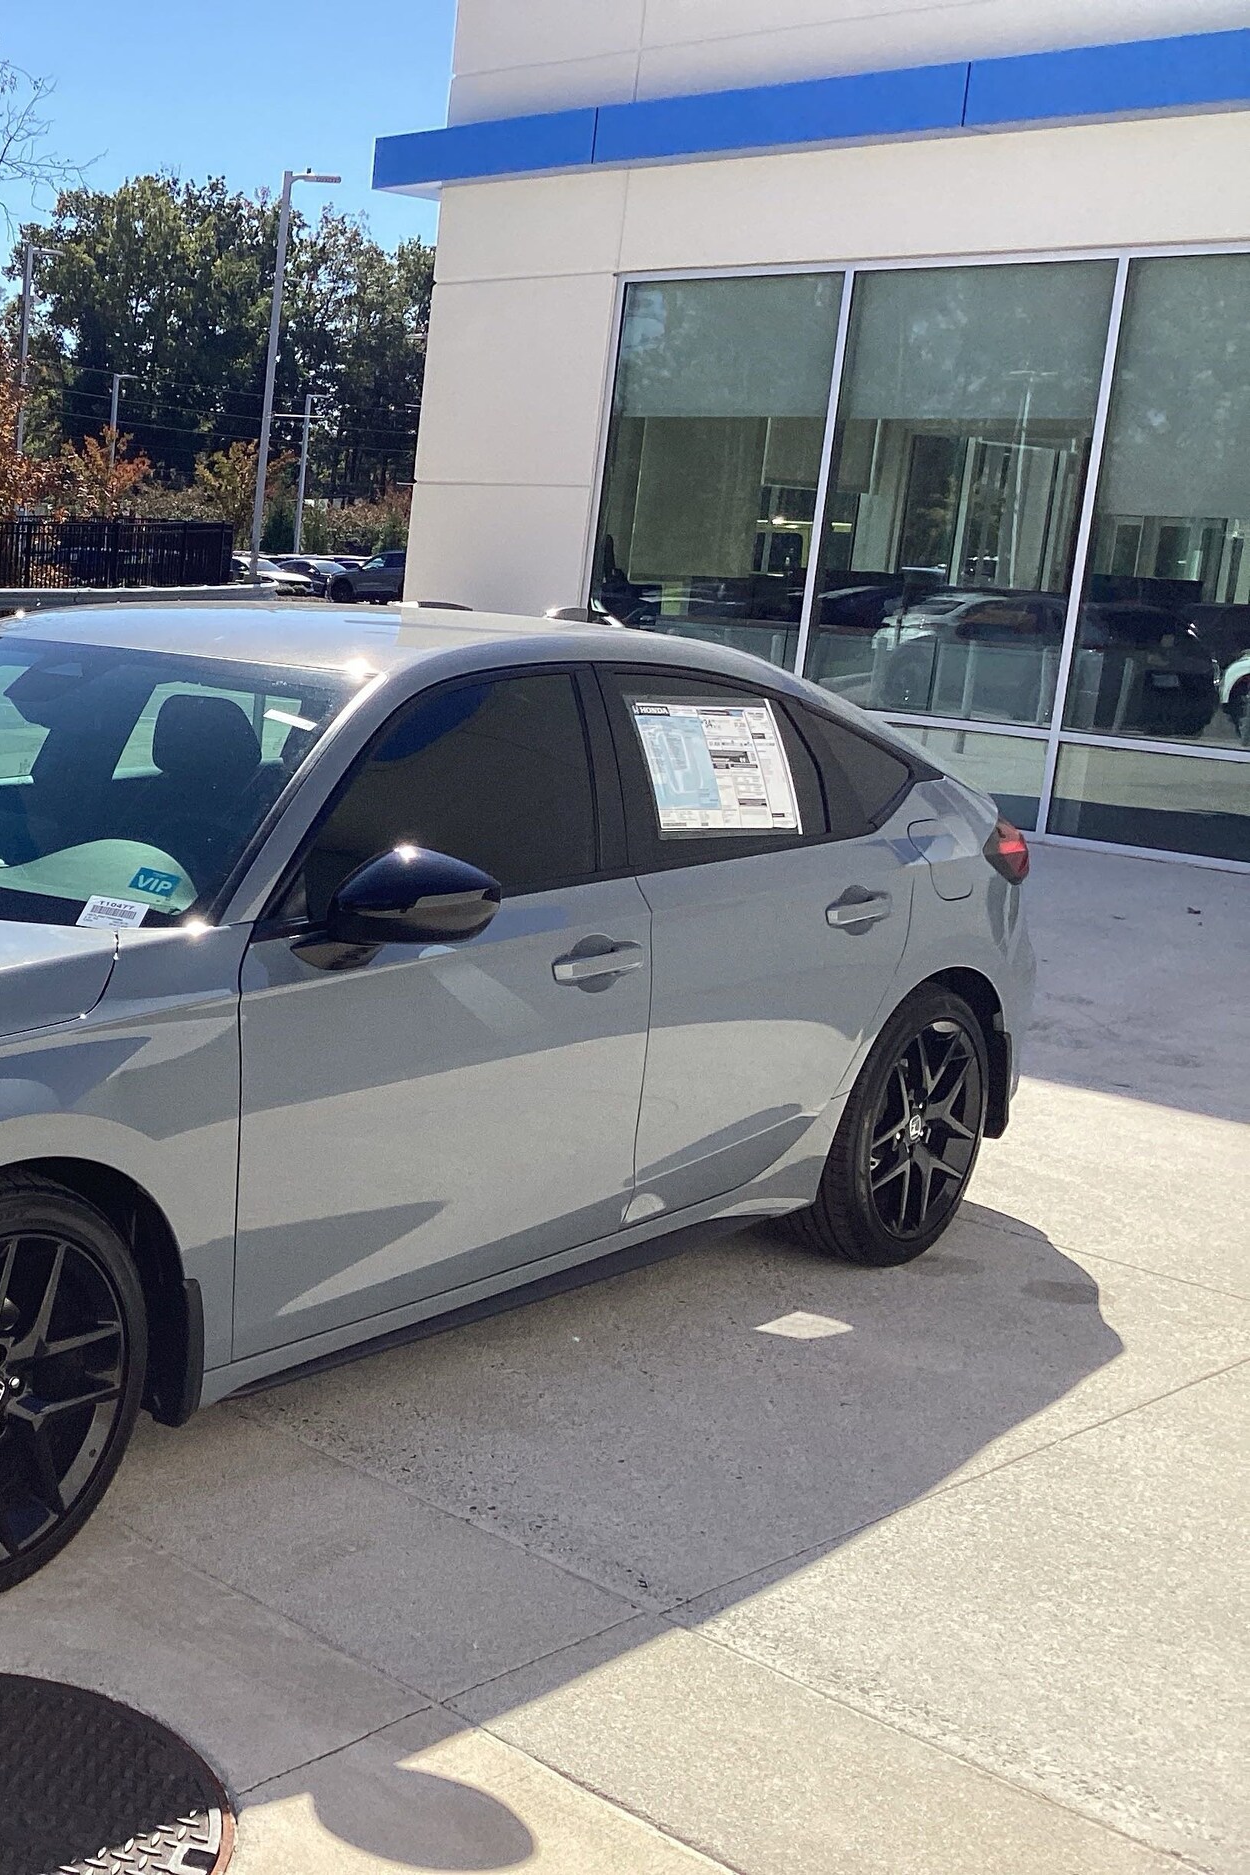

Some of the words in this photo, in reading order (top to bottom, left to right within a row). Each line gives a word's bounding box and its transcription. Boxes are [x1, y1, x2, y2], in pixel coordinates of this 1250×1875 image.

[639, 706, 669, 715] HONDA
[137, 874, 173, 893] VIP
[99, 900, 136, 911] T10477
